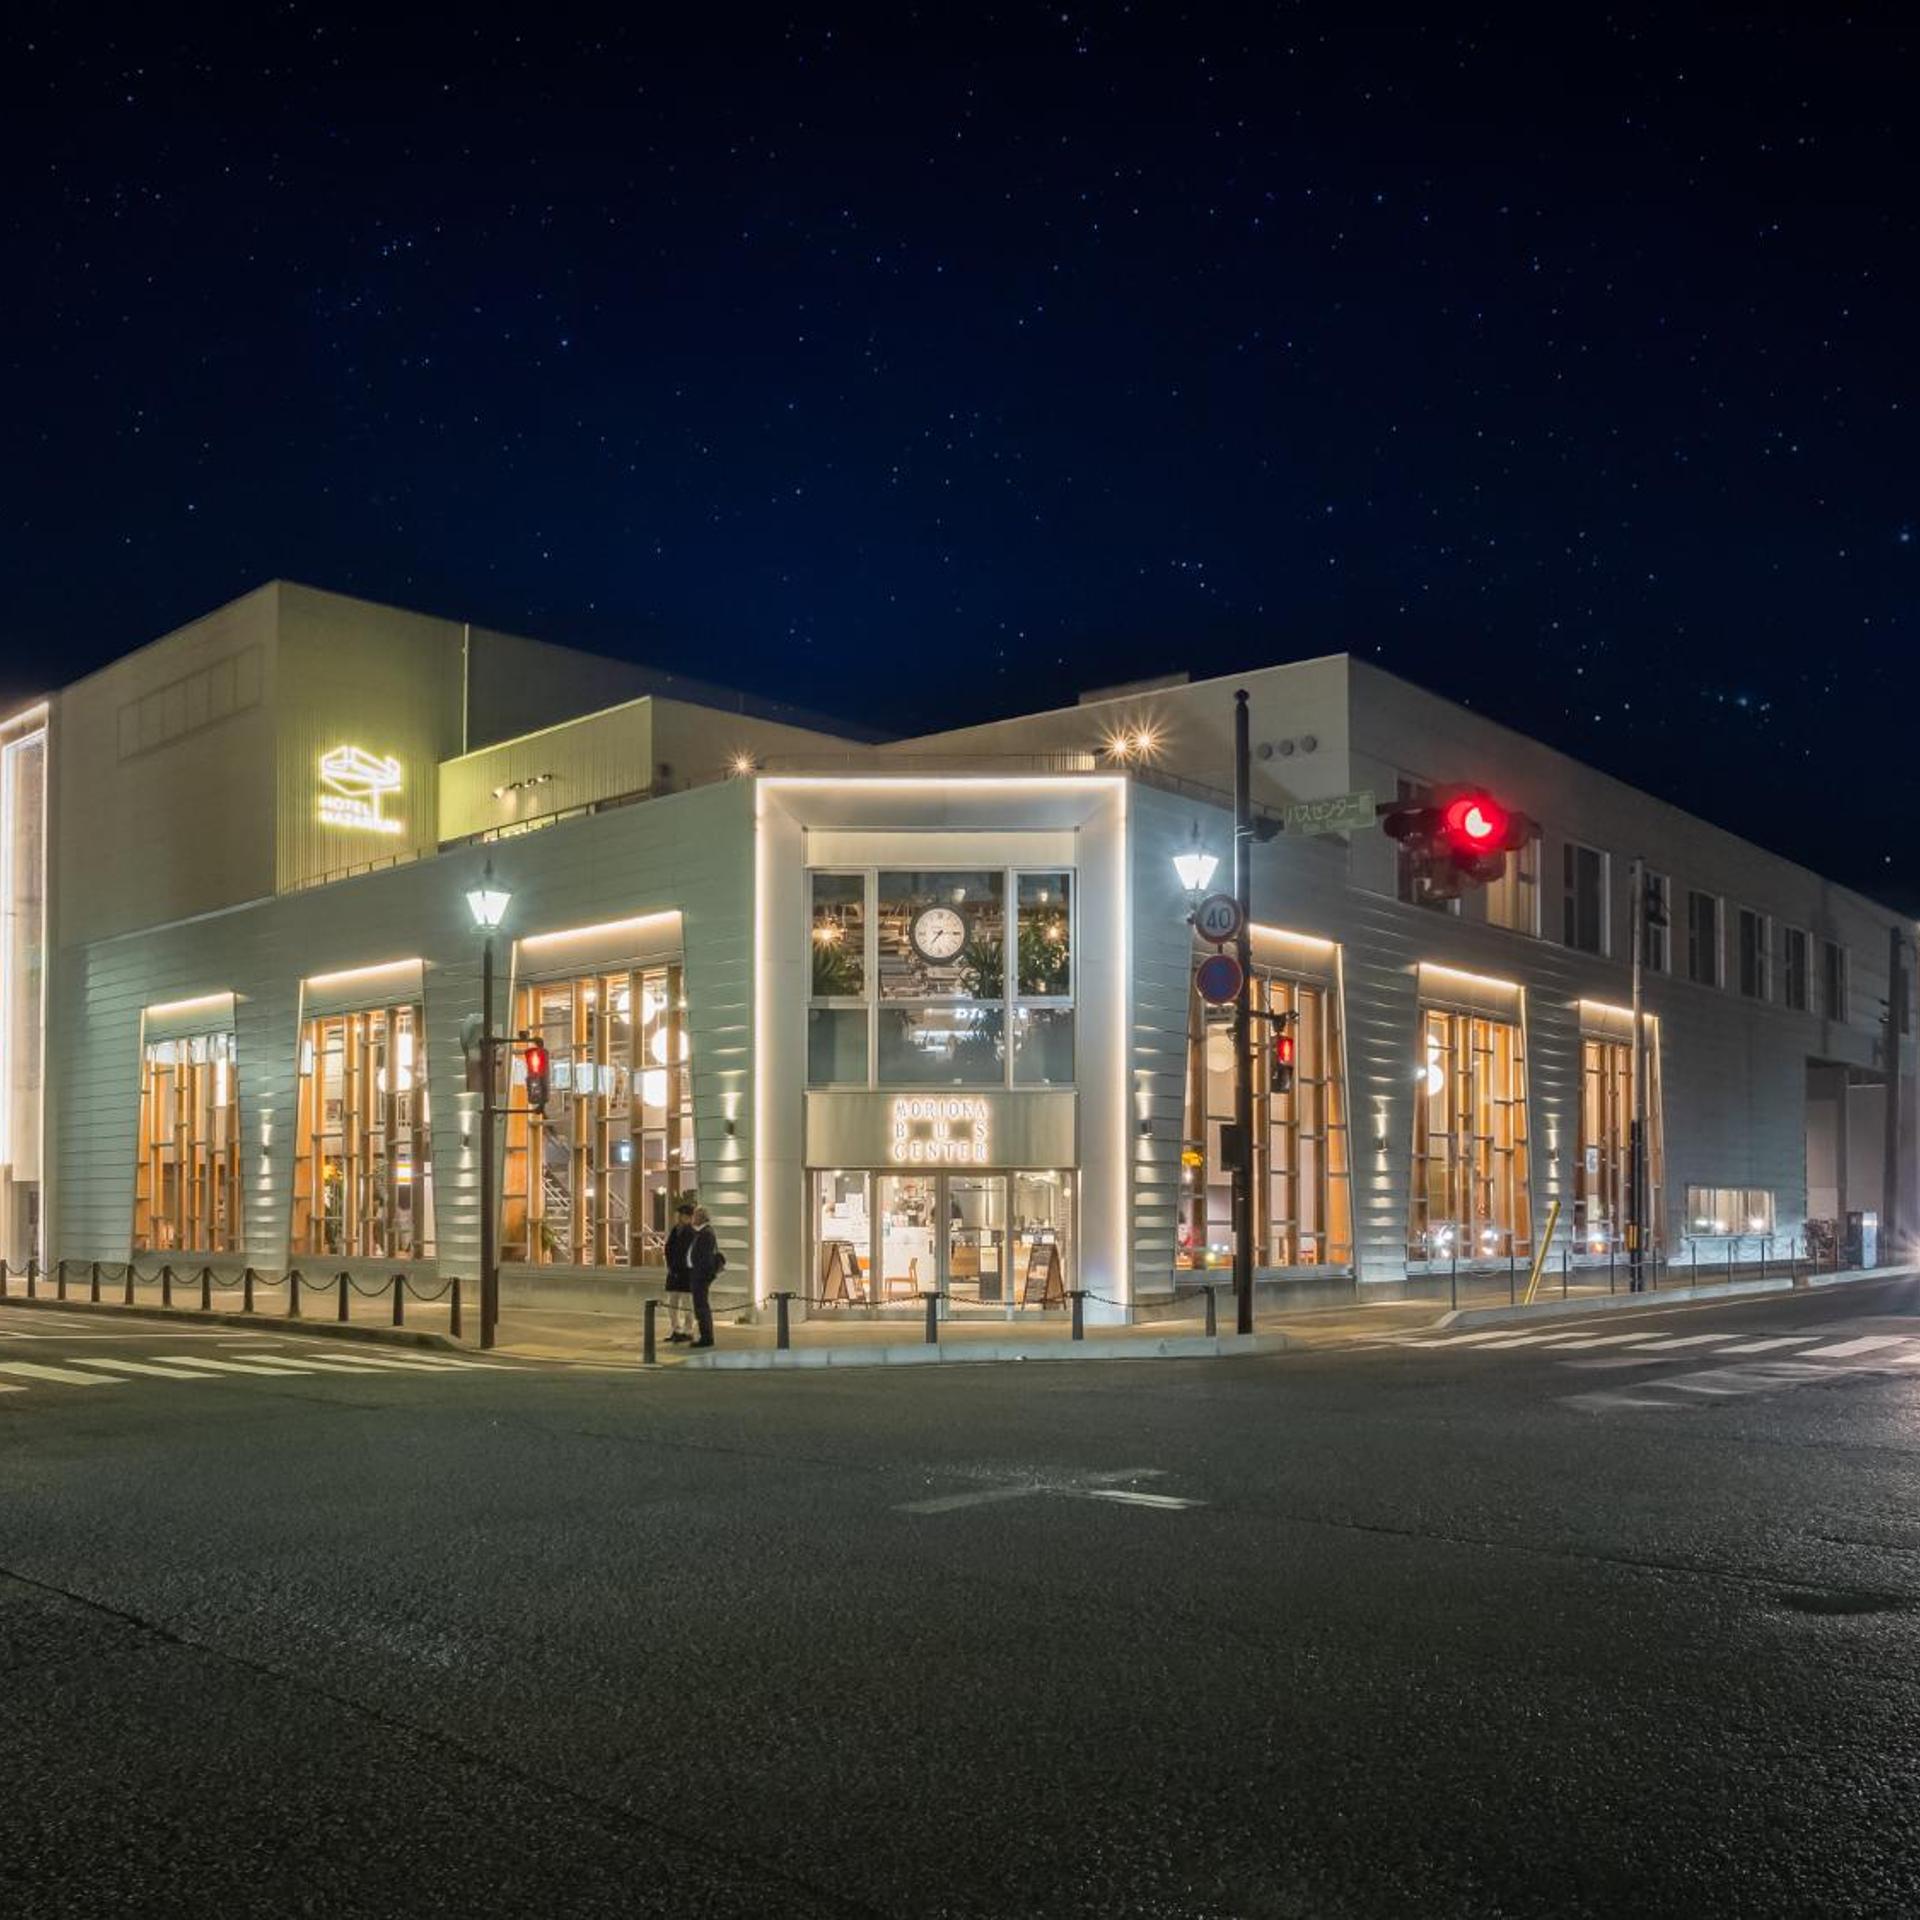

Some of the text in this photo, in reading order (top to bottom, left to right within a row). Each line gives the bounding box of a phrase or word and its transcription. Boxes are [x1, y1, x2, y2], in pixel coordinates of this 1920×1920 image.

[1206, 907, 1231, 929] 40
[895, 1100, 986, 1119] MORIOKA
[894, 1141, 986, 1161] CENTER
